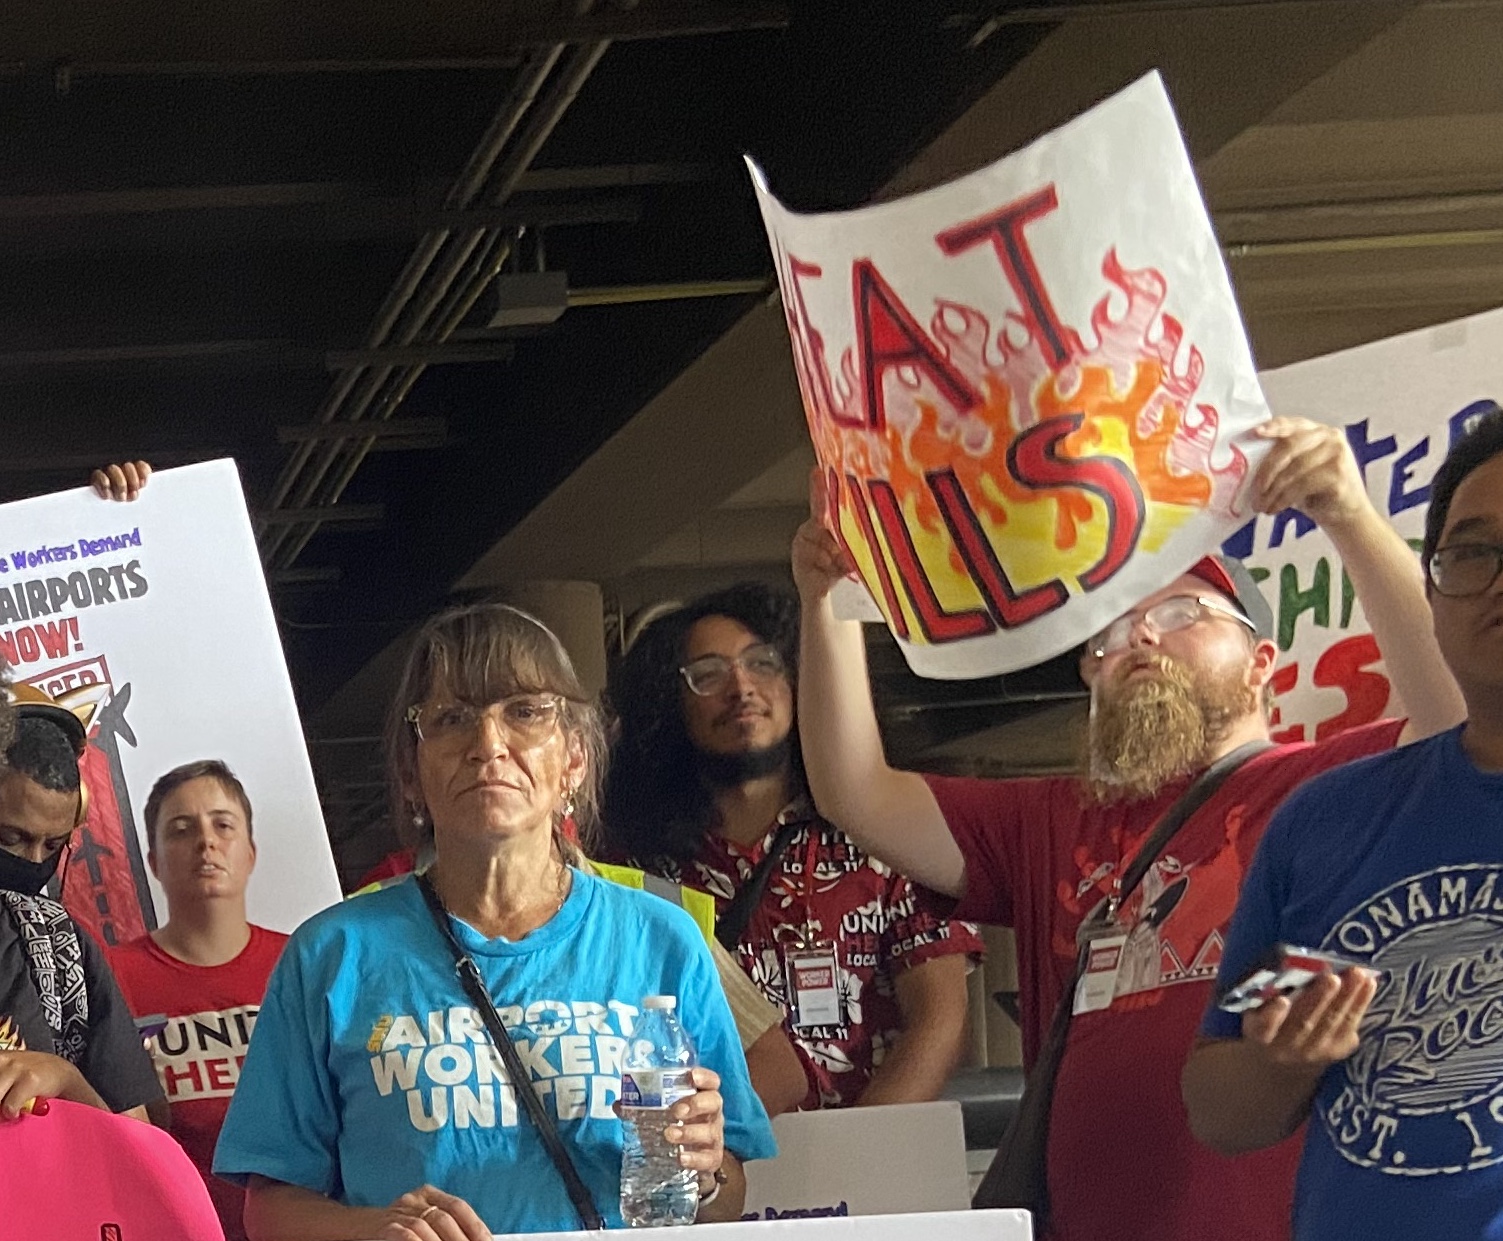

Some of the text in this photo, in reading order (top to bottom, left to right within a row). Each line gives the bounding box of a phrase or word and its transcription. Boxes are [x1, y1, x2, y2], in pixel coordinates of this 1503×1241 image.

[10, 544, 78, 569] Workers
[1338, 872, 1503, 952] ONAMA
[890, 931, 934, 957] OCAL
[380, 1000, 639, 1053] AIRPORT
[163, 1055, 246, 1096] HE
